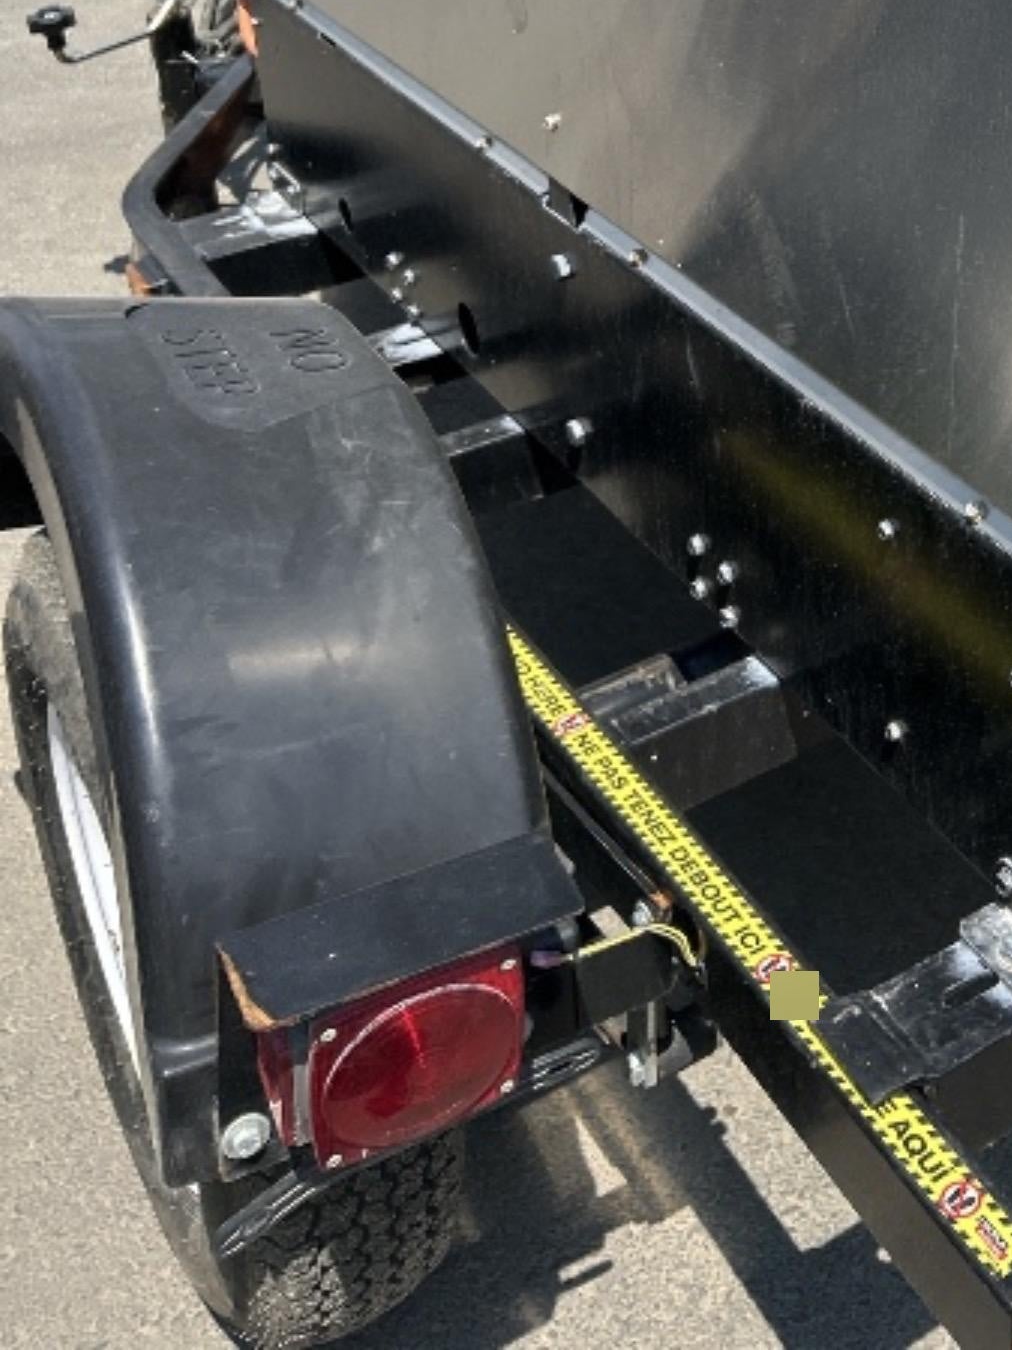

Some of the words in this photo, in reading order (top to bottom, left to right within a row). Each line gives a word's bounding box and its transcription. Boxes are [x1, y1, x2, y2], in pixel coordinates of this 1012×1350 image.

[524, 674, 567, 718] HERE
[573, 732, 601, 756] NE
[593, 756, 628, 791] PAS
[621, 787, 679, 847] TENEZ
[668, 846, 742, 924] DEBOUT
[734, 924, 766, 956] ICI
